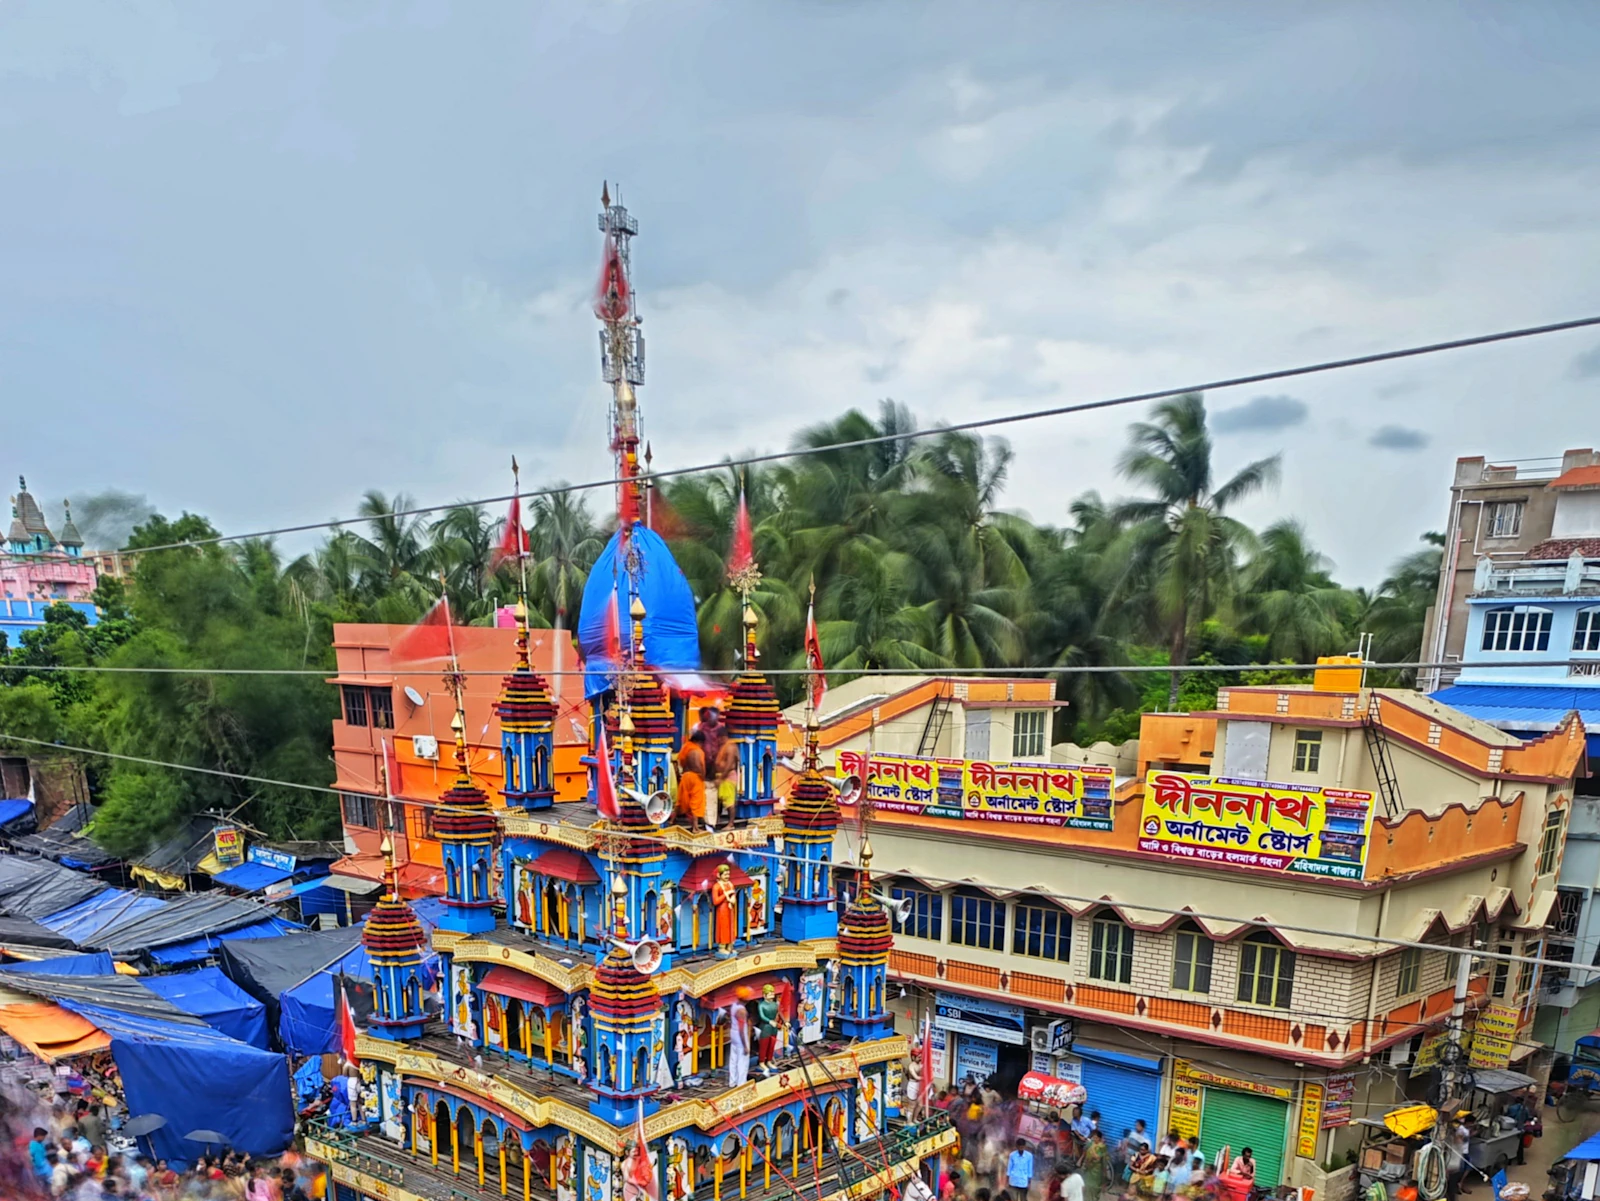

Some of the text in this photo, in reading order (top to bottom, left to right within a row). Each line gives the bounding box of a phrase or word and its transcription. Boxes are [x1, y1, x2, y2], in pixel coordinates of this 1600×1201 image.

[968, 762, 1077, 795] দীননাথ
[1149, 774, 1319, 827] দীননাথ
[947, 1008, 961, 1019] SBI
[1053, 1032, 1072, 1050] ATM
[964, 1048, 991, 1059] Customer
[959, 1056, 996, 1069] Service Point
